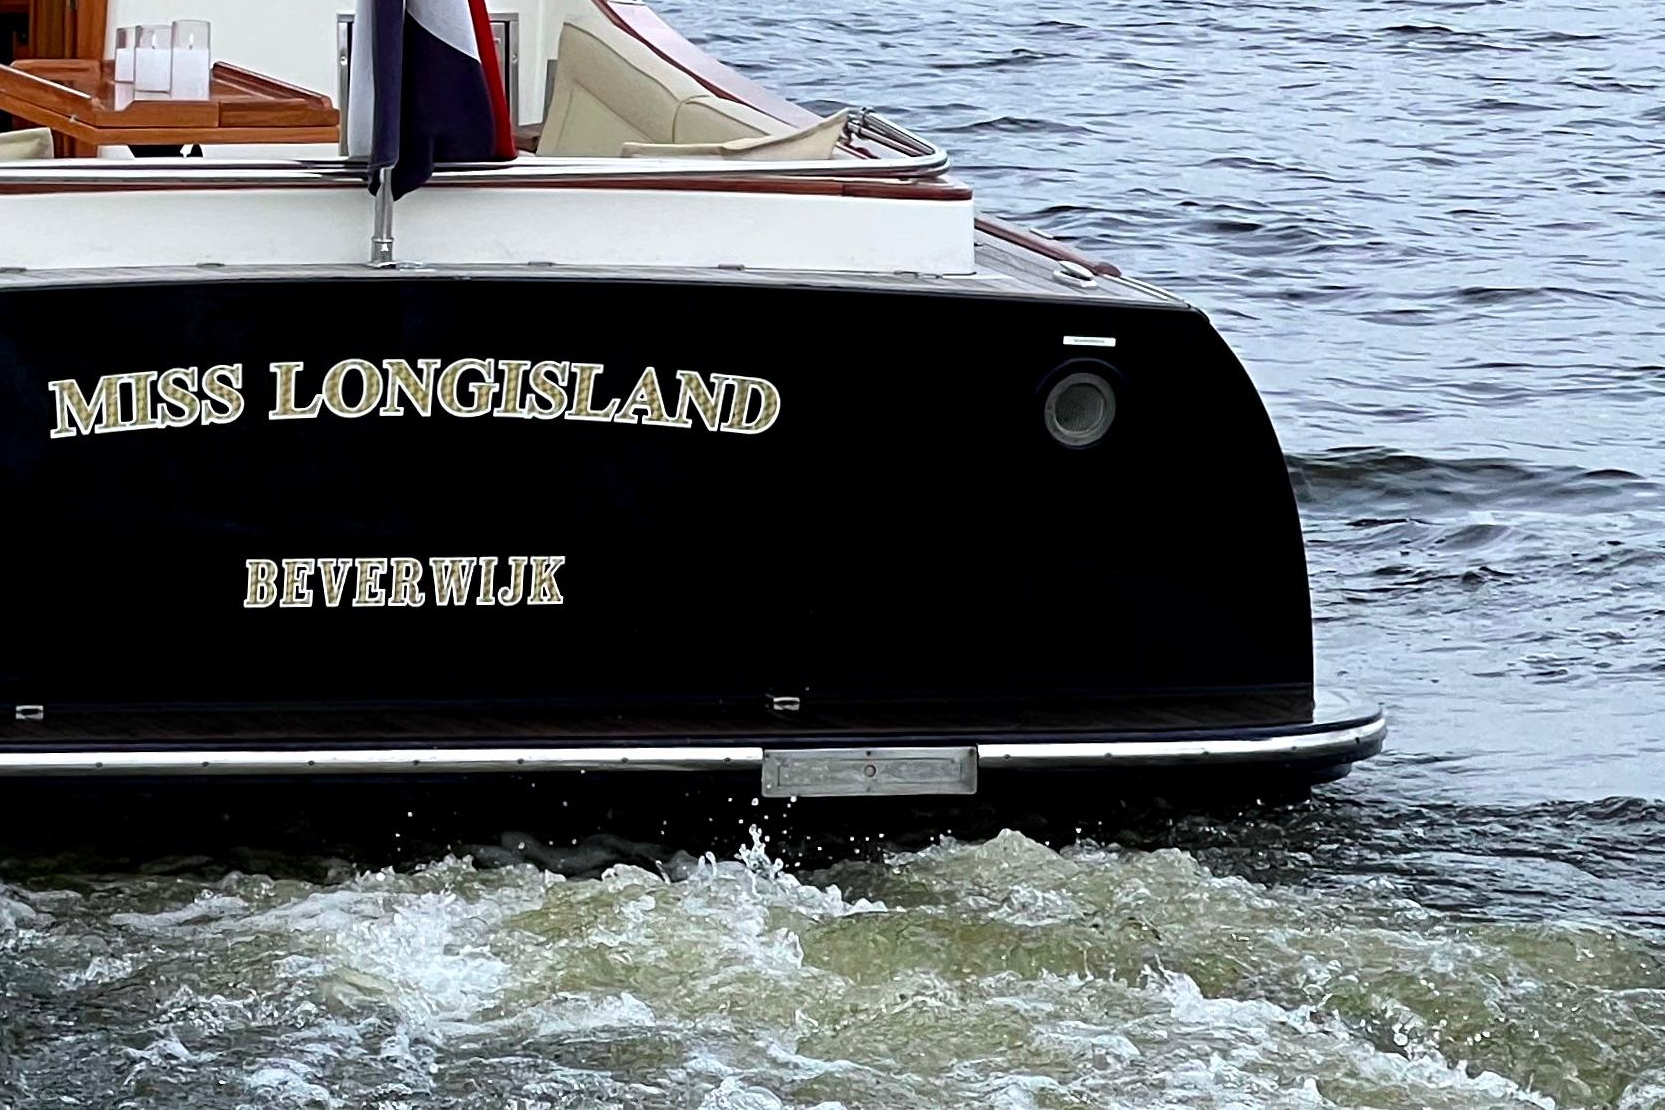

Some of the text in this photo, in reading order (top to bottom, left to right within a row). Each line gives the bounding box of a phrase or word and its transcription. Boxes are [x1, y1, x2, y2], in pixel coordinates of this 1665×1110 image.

[48, 358, 781, 439] MISS LONGISLAND
[243, 556, 566, 608] BEVERWIJK
